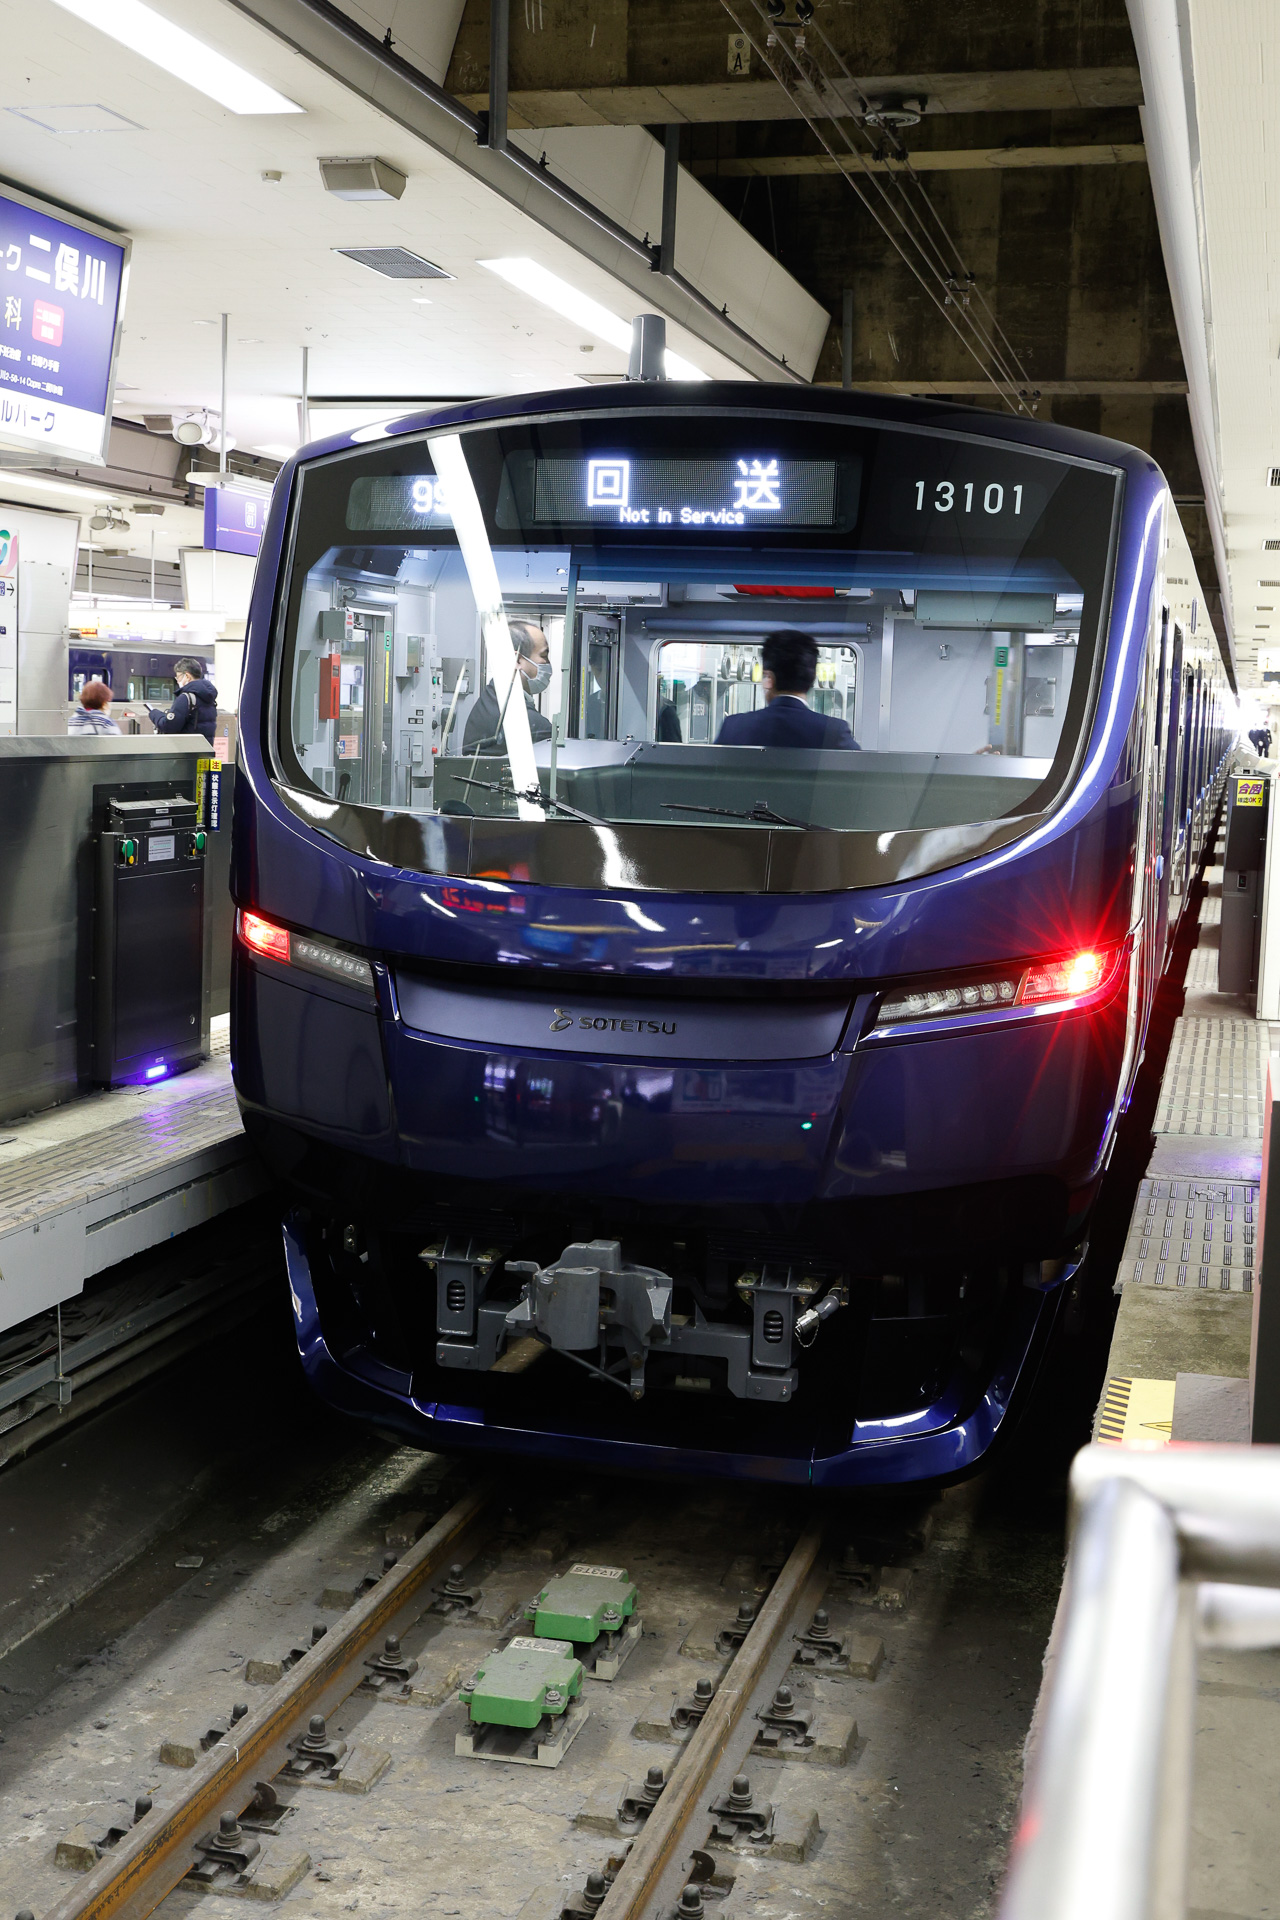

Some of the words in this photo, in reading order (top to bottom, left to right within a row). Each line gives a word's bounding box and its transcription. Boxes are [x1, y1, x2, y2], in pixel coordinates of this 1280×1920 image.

[733, 52, 743, 70] A
[0, 233, 106, 306] ク二俣川
[4, 296, 22, 331] 科
[915, 481, 1023, 515] 13101
[619, 507, 650, 523] Not
[658, 507, 672, 524] in
[680, 507, 745, 525] Service
[579, 1017, 677, 1035] SOTETSU
